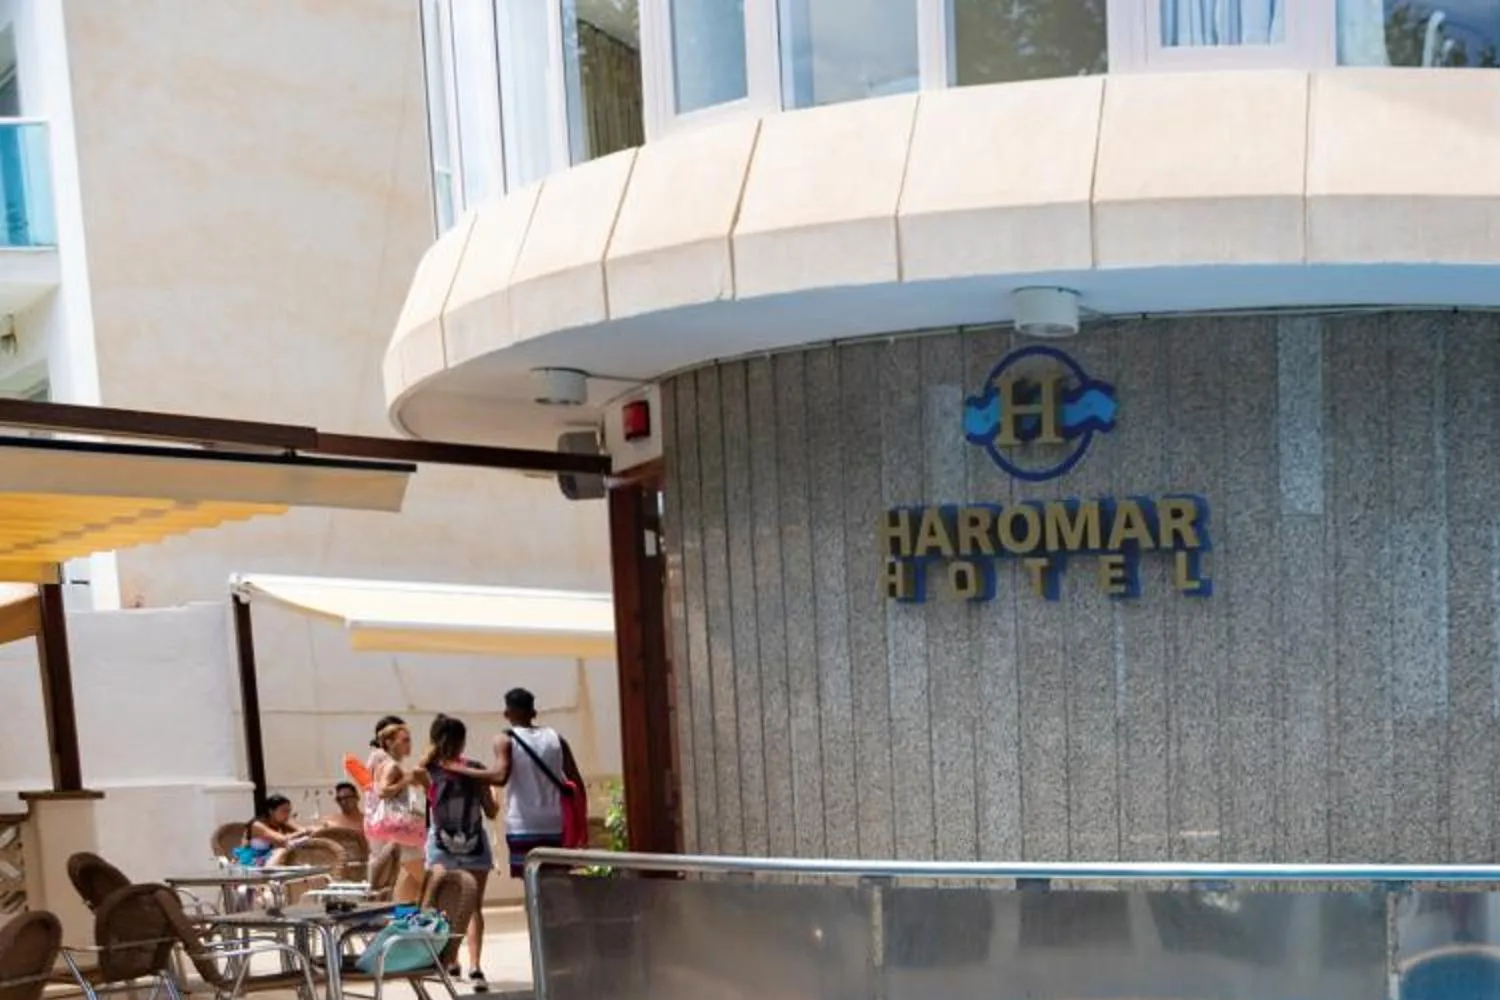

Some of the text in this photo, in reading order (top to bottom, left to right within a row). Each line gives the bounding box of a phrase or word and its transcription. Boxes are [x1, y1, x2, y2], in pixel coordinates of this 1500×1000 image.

[994, 372, 1064, 447] H
[879, 497, 1204, 557] HAROMAR
[880, 550, 1204, 600] HOTEL
